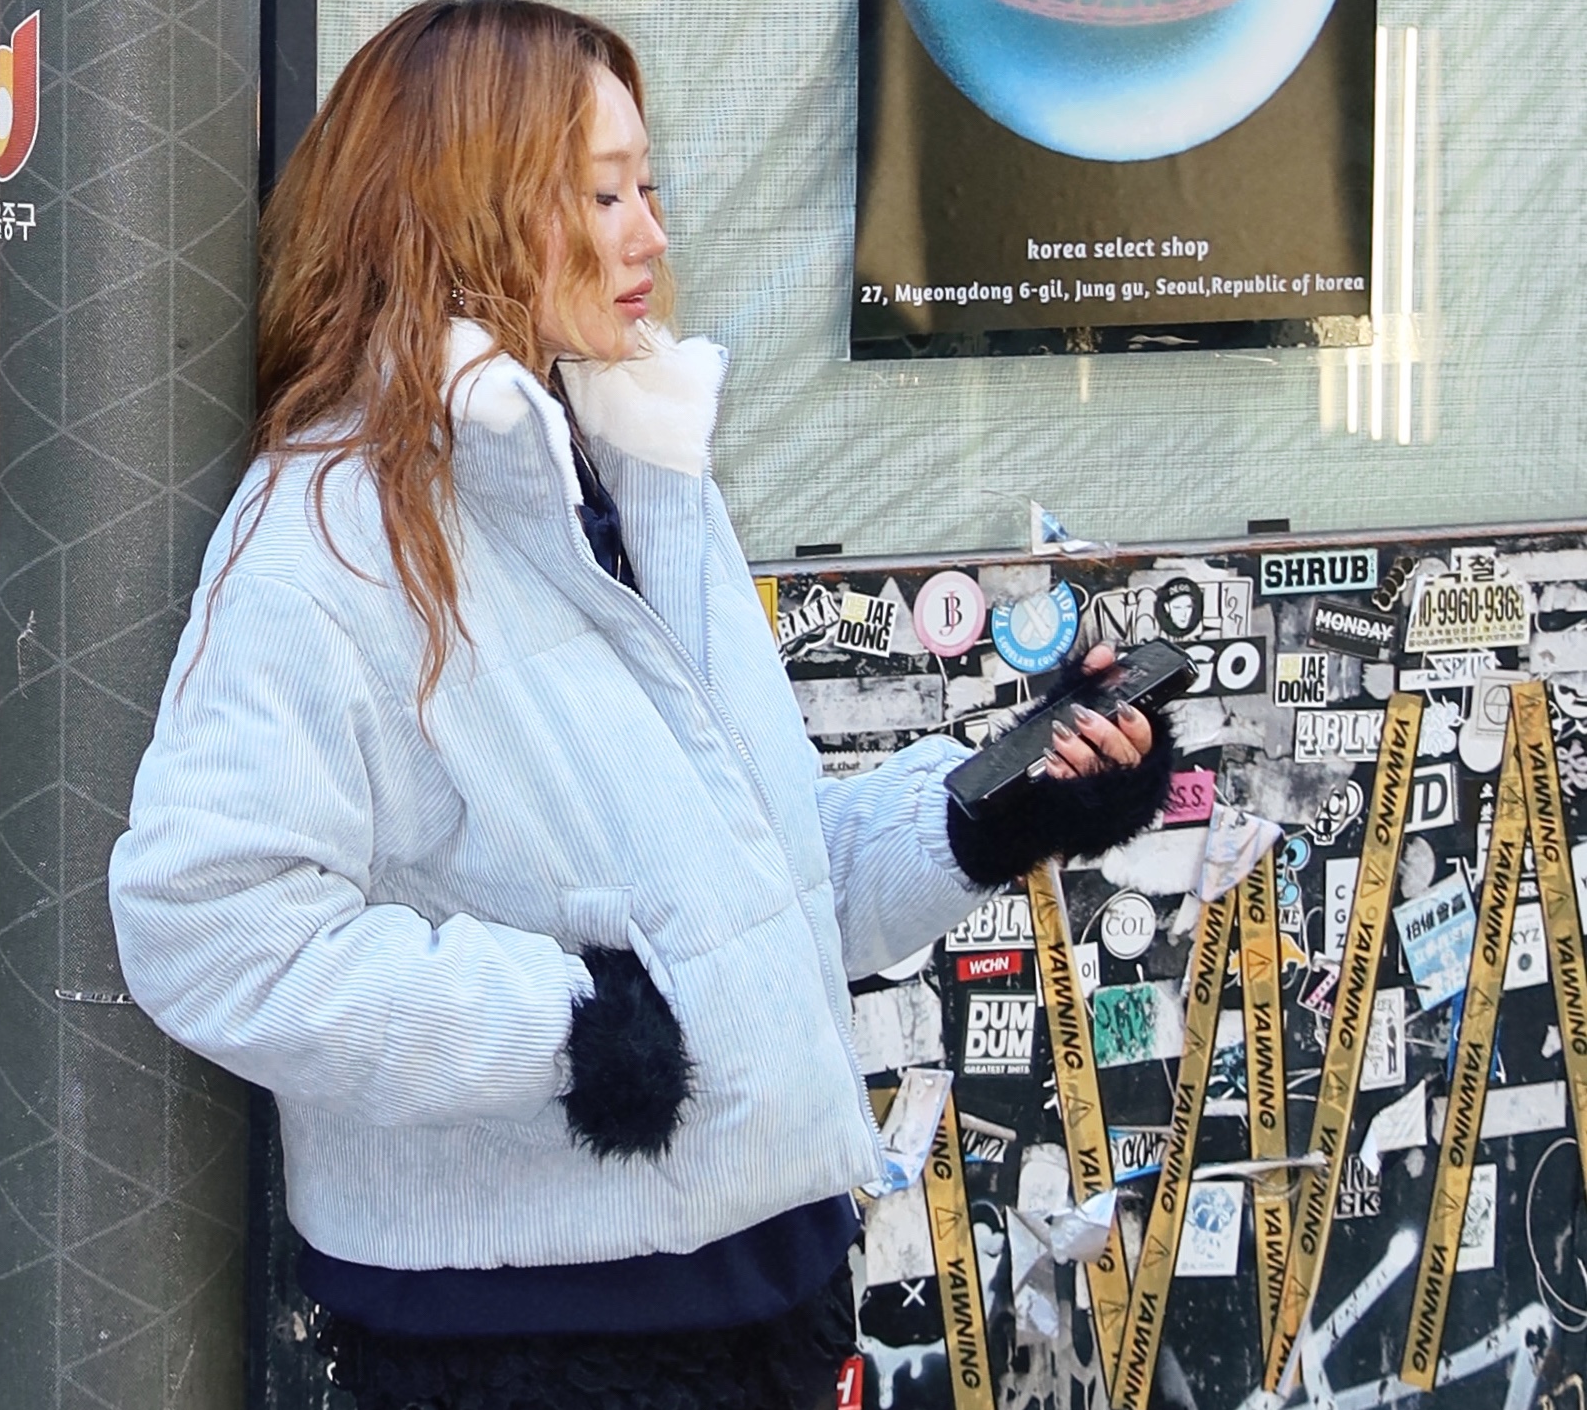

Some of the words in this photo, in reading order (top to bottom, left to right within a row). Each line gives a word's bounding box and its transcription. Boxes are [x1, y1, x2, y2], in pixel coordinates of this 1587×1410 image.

[1027, 238, 1087, 260] korea
[1094, 237, 1156, 258] select
[1161, 237, 1210, 261] shop
[860, 286, 889, 306] 27,
[894, 281, 1013, 306] Myeongdong
[1019, 280, 1070, 303] 6-gil,
[1074, 279, 1116, 303] Jung
[1121, 281, 1151, 301] gu,
[1292, 273, 1311, 295] of
[1316, 273, 1365, 292] korea
[1264, 555, 1369, 588] SHRUB
[865, 599, 895, 627] JAE
[1315, 609, 1395, 642] MONDAY
[837, 619, 890, 652] DONG
[1300, 656, 1324, 680] JAE
[1278, 681, 1325, 704] DONG
[1376, 719, 1410, 846] YAWNING
[1527, 741, 1560, 863] YAWNING
[1483, 840, 1514, 967] YAWNING
[969, 956, 1010, 975] WCHN
[1339, 921, 1374, 1051] YAWNING
[1556, 935, 1587, 1056] YAWNING
[971, 1001, 1034, 1031] DUM
[1047, 942, 1083, 1070] YAWNING
[965, 1030, 1032, 1058] DUM
[964, 1065, 1005, 1074] GREATEST
[1253, 1001, 1276, 1130] YAWNING
[1449, 1041, 1483, 1169] YAWNING
[1161, 1082, 1196, 1214] YAWNING
[946, 1258, 981, 1389] YAWNING
[1413, 1243, 1449, 1375] YAWNING
